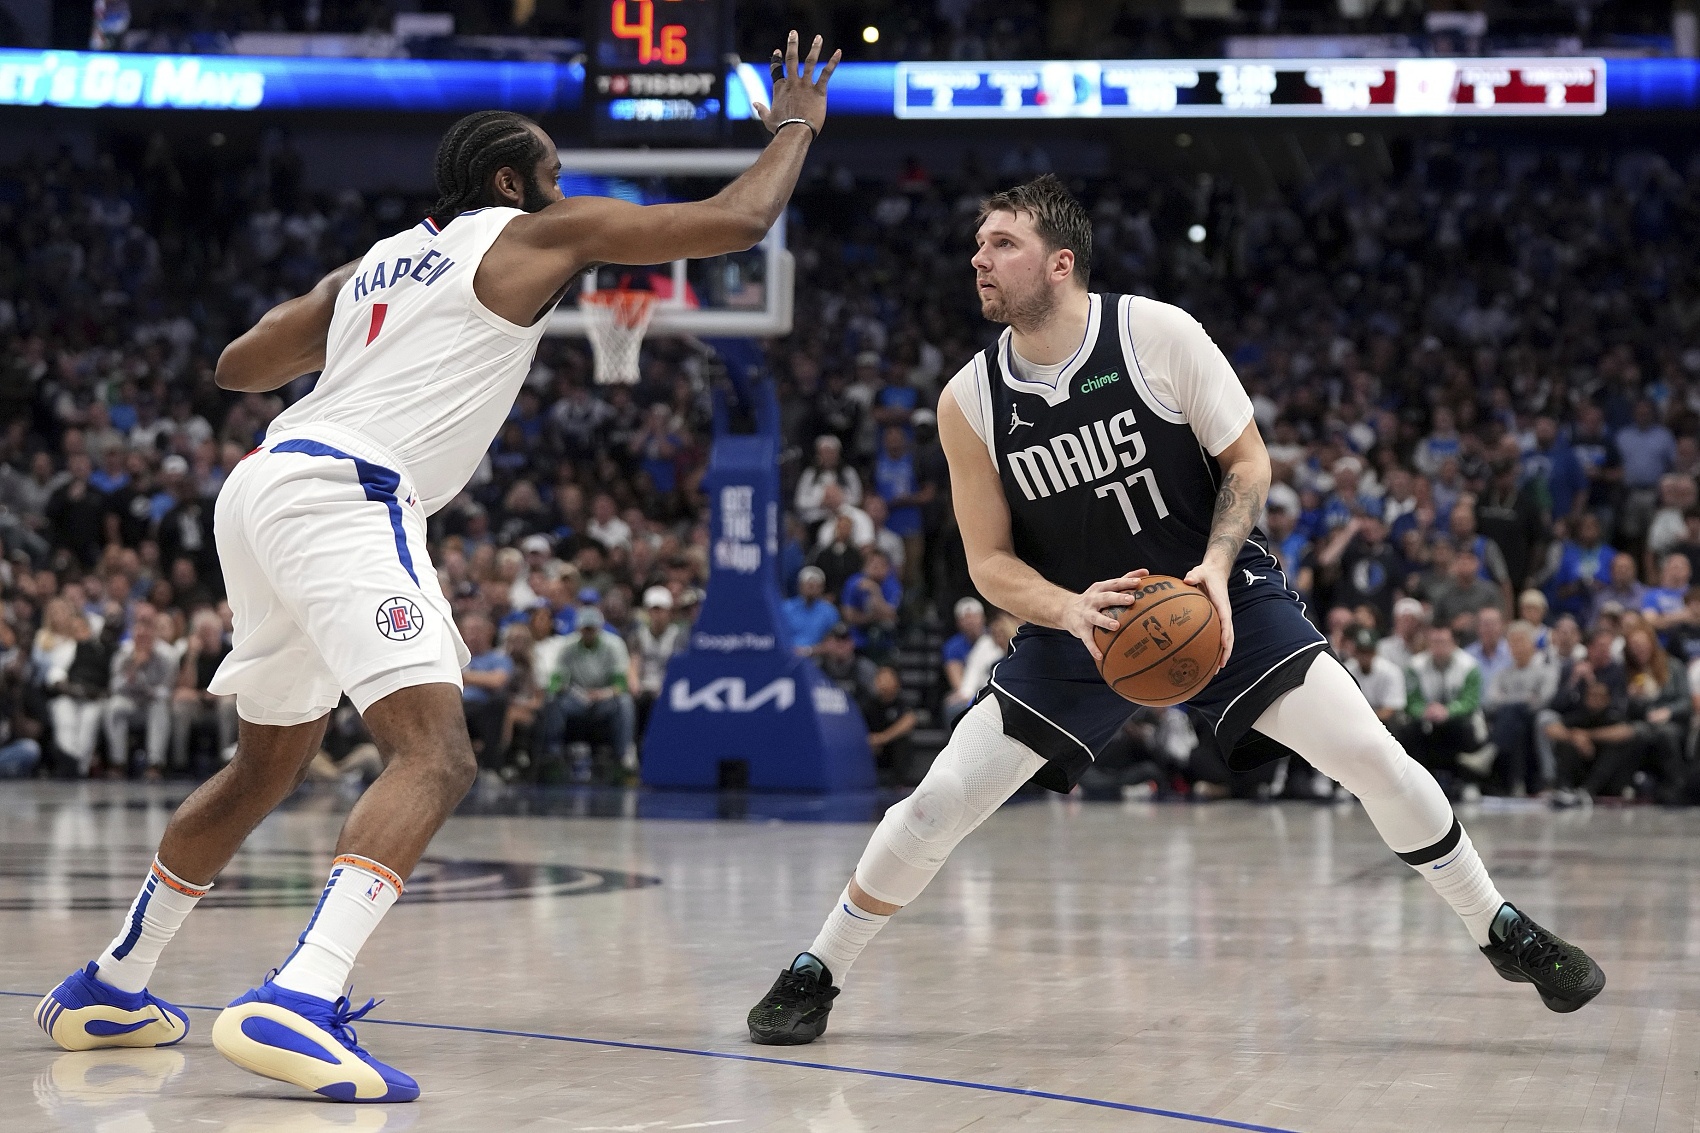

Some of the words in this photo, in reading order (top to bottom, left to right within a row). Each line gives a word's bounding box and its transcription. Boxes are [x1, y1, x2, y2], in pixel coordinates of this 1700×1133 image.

[611, 0, 687, 64] 4.6
[366, 303, 389, 347] 1
[1080, 371, 1120, 394] chime
[1007, 408, 1147, 501] MAVS
[1094, 467, 1170, 536] 77
[670, 678, 796, 712] KIA
